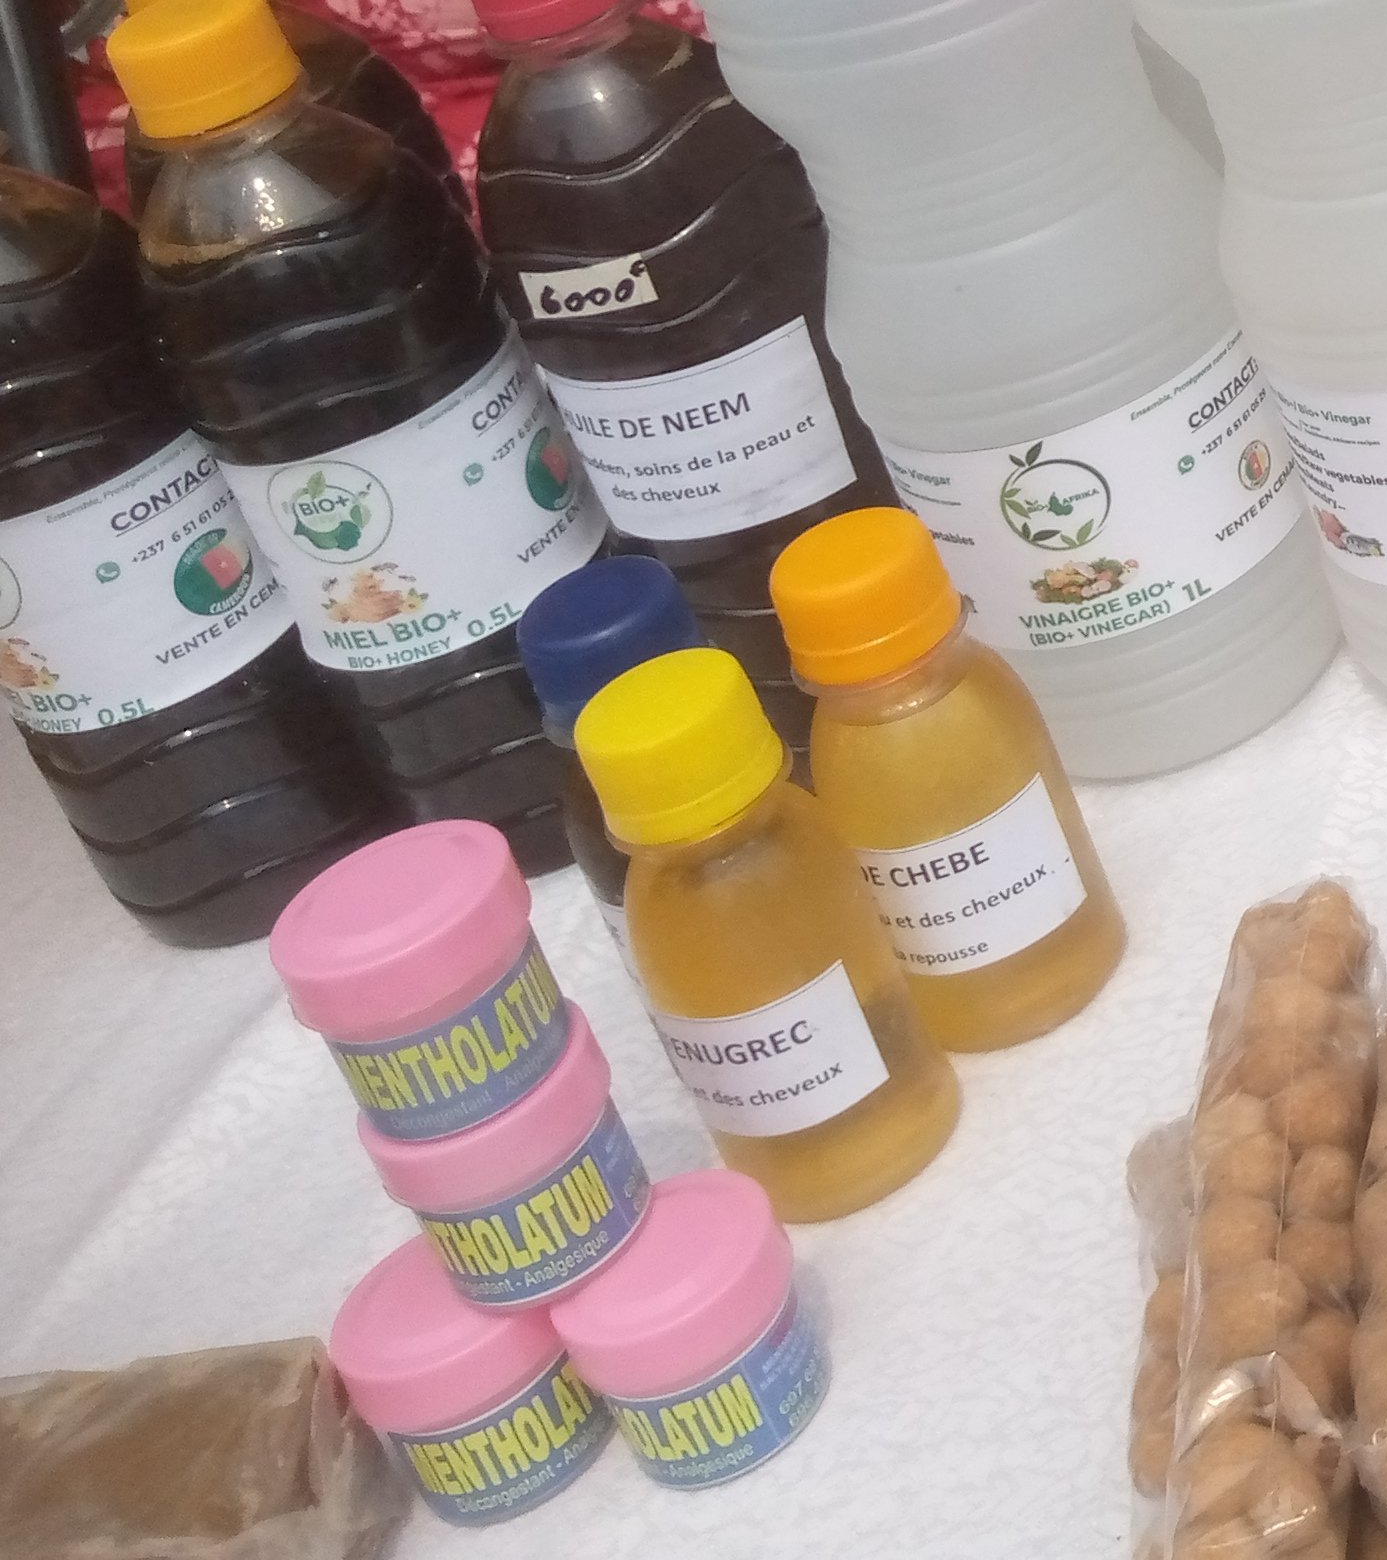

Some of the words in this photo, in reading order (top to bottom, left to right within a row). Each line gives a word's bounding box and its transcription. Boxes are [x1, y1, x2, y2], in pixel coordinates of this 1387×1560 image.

[618, 417, 656, 439] DE
[661, 391, 752, 436] NEEM
[1188, 355, 1260, 430] CONTACT:
[1320, 409, 1372, 427] Vinegar
[634, 462, 683, 477] soins
[687, 456, 713, 472] de
[716, 449, 738, 466] la
[742, 427, 793, 461] peau
[795, 414, 817, 435] et
[1201, 434, 1225, 456] +237
[298, 493, 350, 518] BIO+
[641, 480, 722, 503] cheveux
[1062, 488, 1101, 506] AFRIKA
[131, 539, 165, 563] +237
[171, 530, 182, 543] 6
[182, 520, 197, 537] 51
[198, 509, 213, 525] 61
[1214, 504, 1259, 542] VENTE
[1258, 489, 1274, 510] EN
[516, 517, 567, 565] VENTE
[323, 629, 389, 651] MIEL
[387, 608, 463, 643] BIO+
[466, 601, 524, 638] 0.5L
[1018, 597, 1124, 630] VINAIGRE
[1126, 578, 1176, 608] BIO+
[1181, 577, 1213, 603] 1L
[1029, 628, 1075, 648] (BIO+
[1077, 599, 1172, 639] VINEGAR)
[155, 622, 223, 666] VENTE
[223, 604, 249, 630] EN
[347, 655, 383, 670] BIO+
[386, 636, 452, 666] HONEY
[31, 692, 93, 713] BIO+
[97, 697, 156, 726] 0.5L
[889, 841, 990, 888] CHEBE
[896, 914, 915, 929] et
[919, 910, 957, 930] des
[910, 940, 990, 967] repousse
[749, 1061, 844, 1107] cheveux
